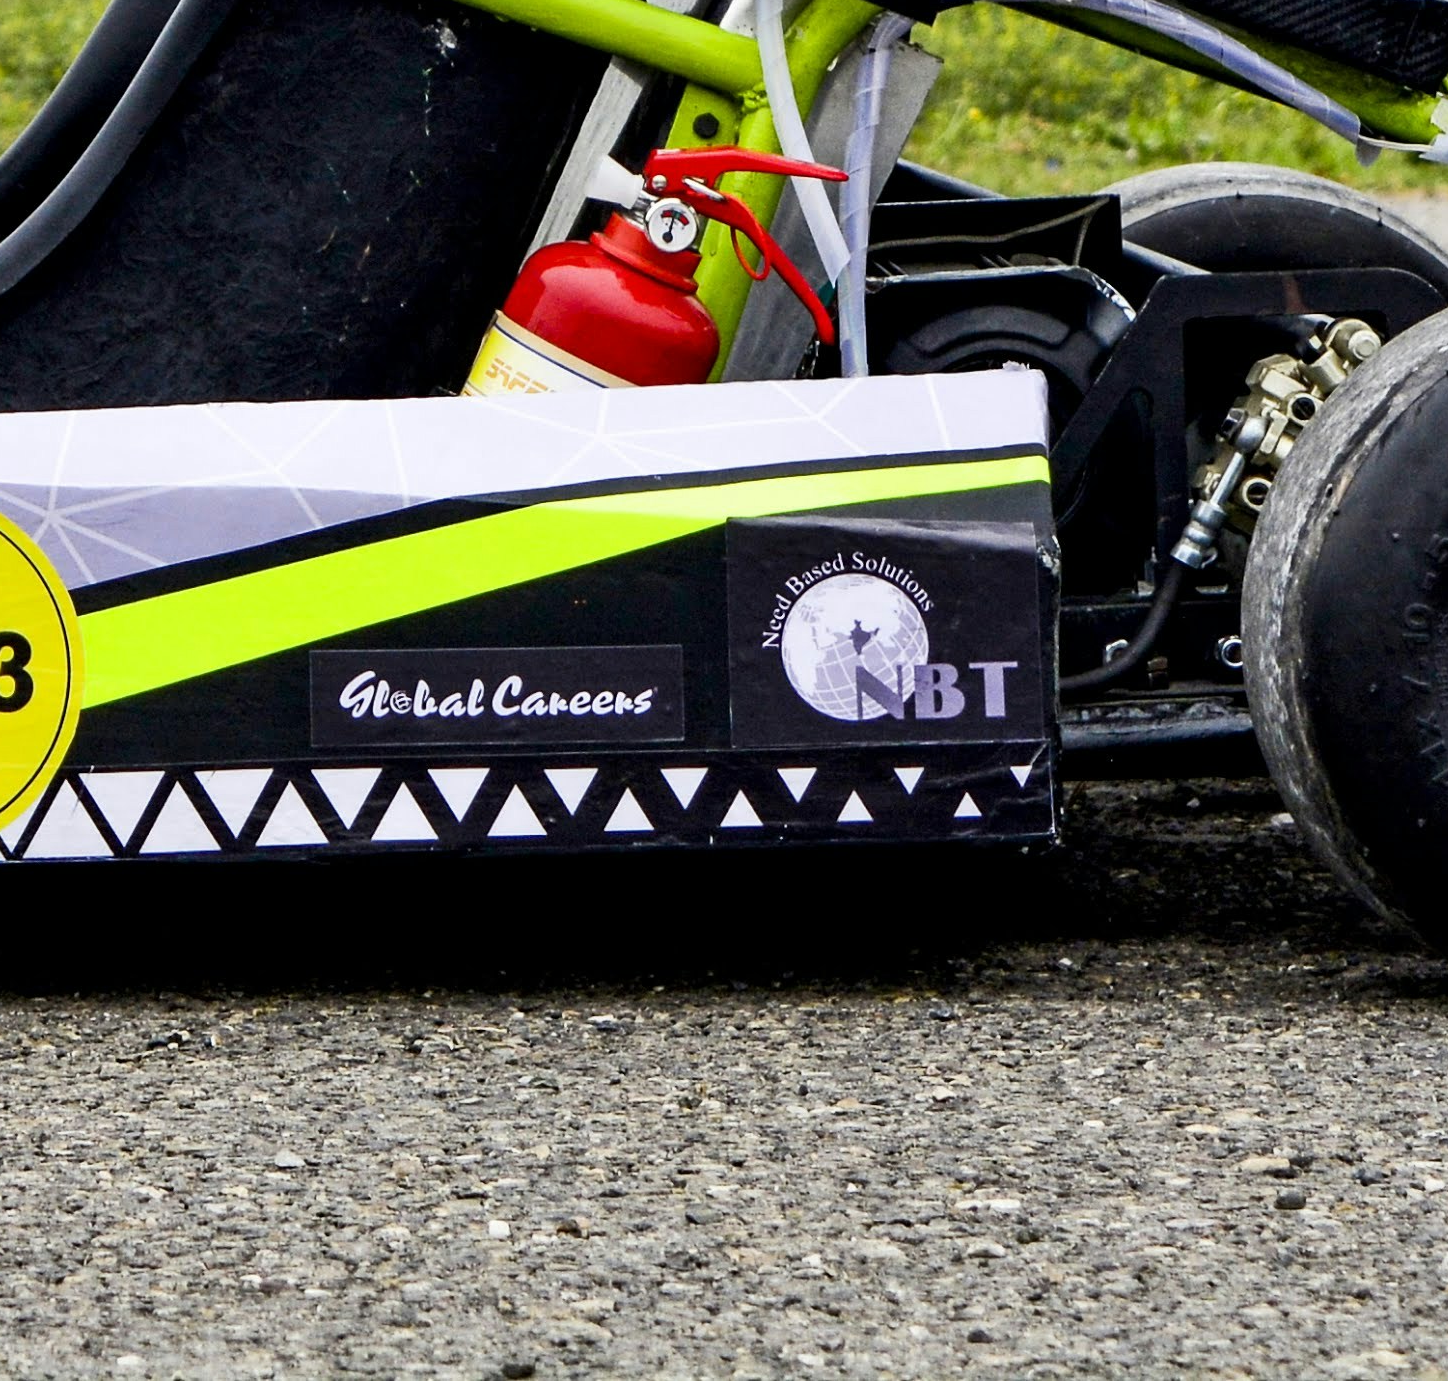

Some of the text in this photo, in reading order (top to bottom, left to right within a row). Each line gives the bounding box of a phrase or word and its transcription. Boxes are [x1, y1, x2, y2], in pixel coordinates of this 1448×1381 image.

[762, 551, 934, 649] Need Based Solutions
[339, 670, 654, 718] Global Careers
[856, 661, 1018, 719] NBT
